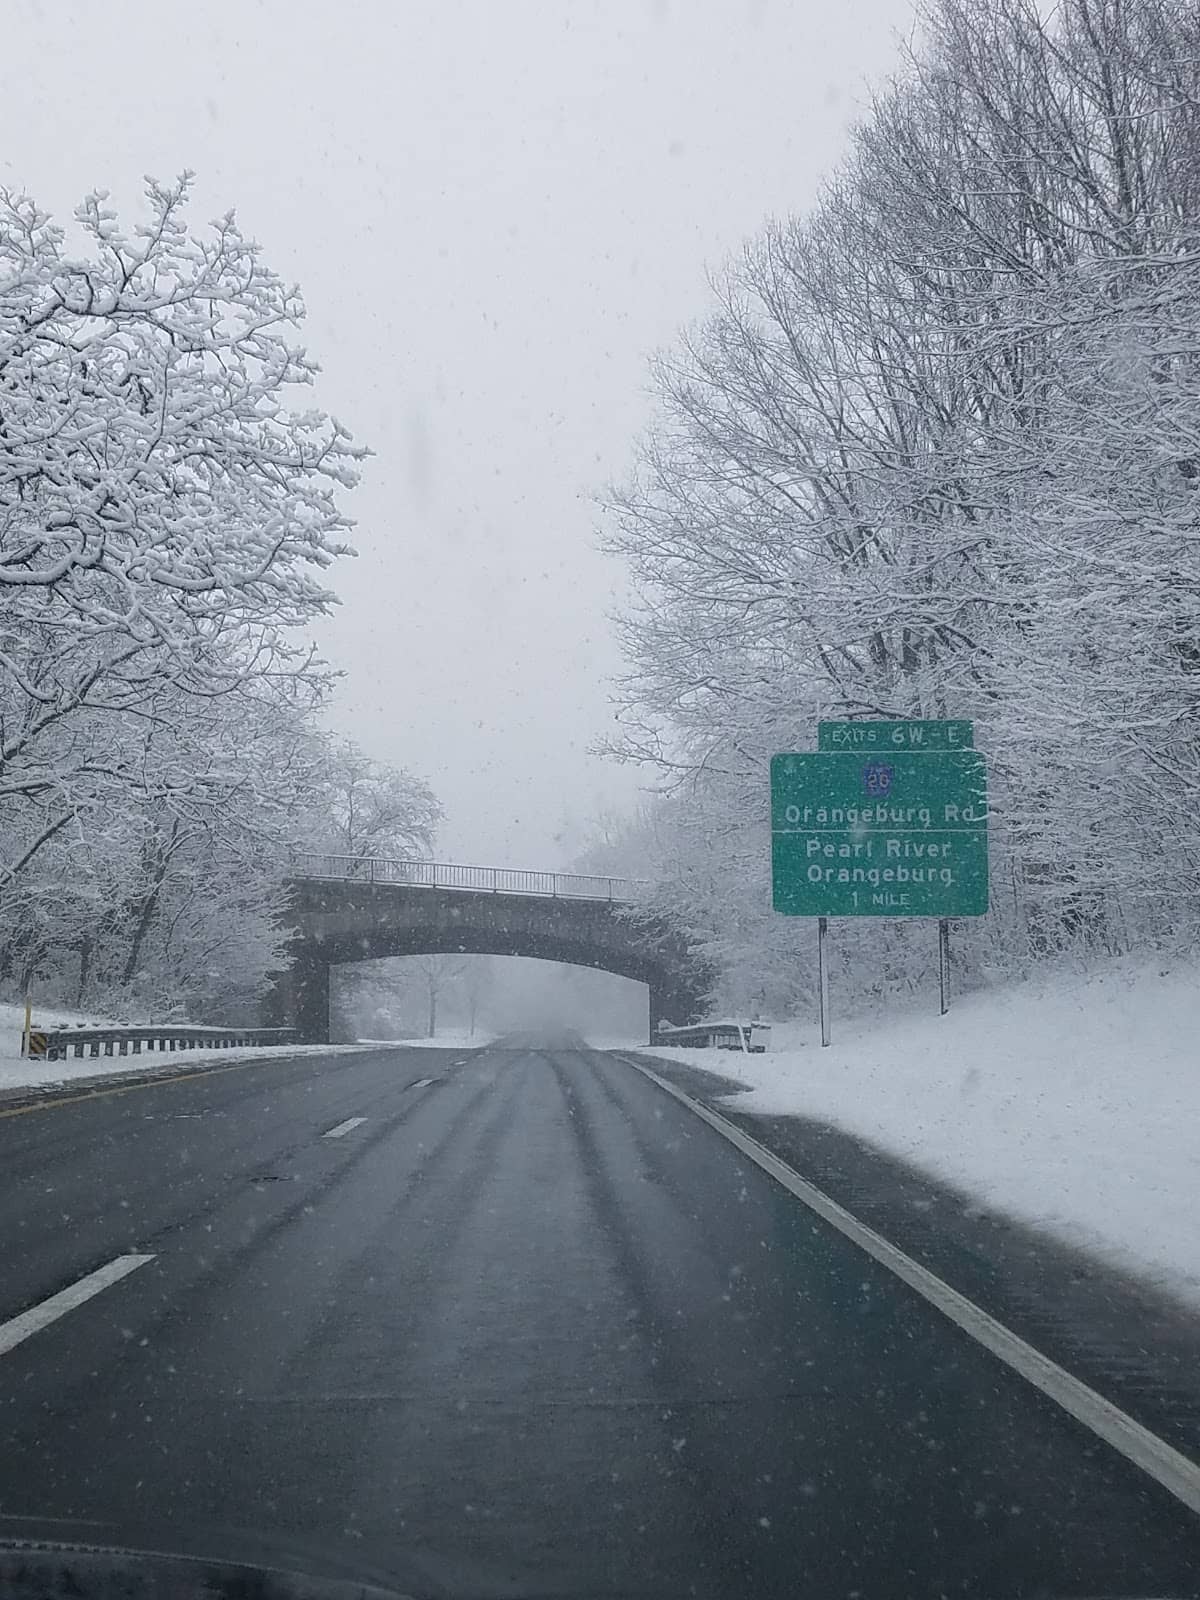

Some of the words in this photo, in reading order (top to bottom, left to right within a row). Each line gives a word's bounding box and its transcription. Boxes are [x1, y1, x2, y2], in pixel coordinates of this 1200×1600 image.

[867, 774, 889, 788] 20
[784, 804, 931, 828] Orangeburg
[944, 804, 975, 822] Rd
[805, 839, 873, 858] Pearl
[885, 839, 952, 857] River
[807, 864, 955, 887] Orangeburg
[851, 891, 859, 907] 1
[872, 892, 911, 905] MILE
